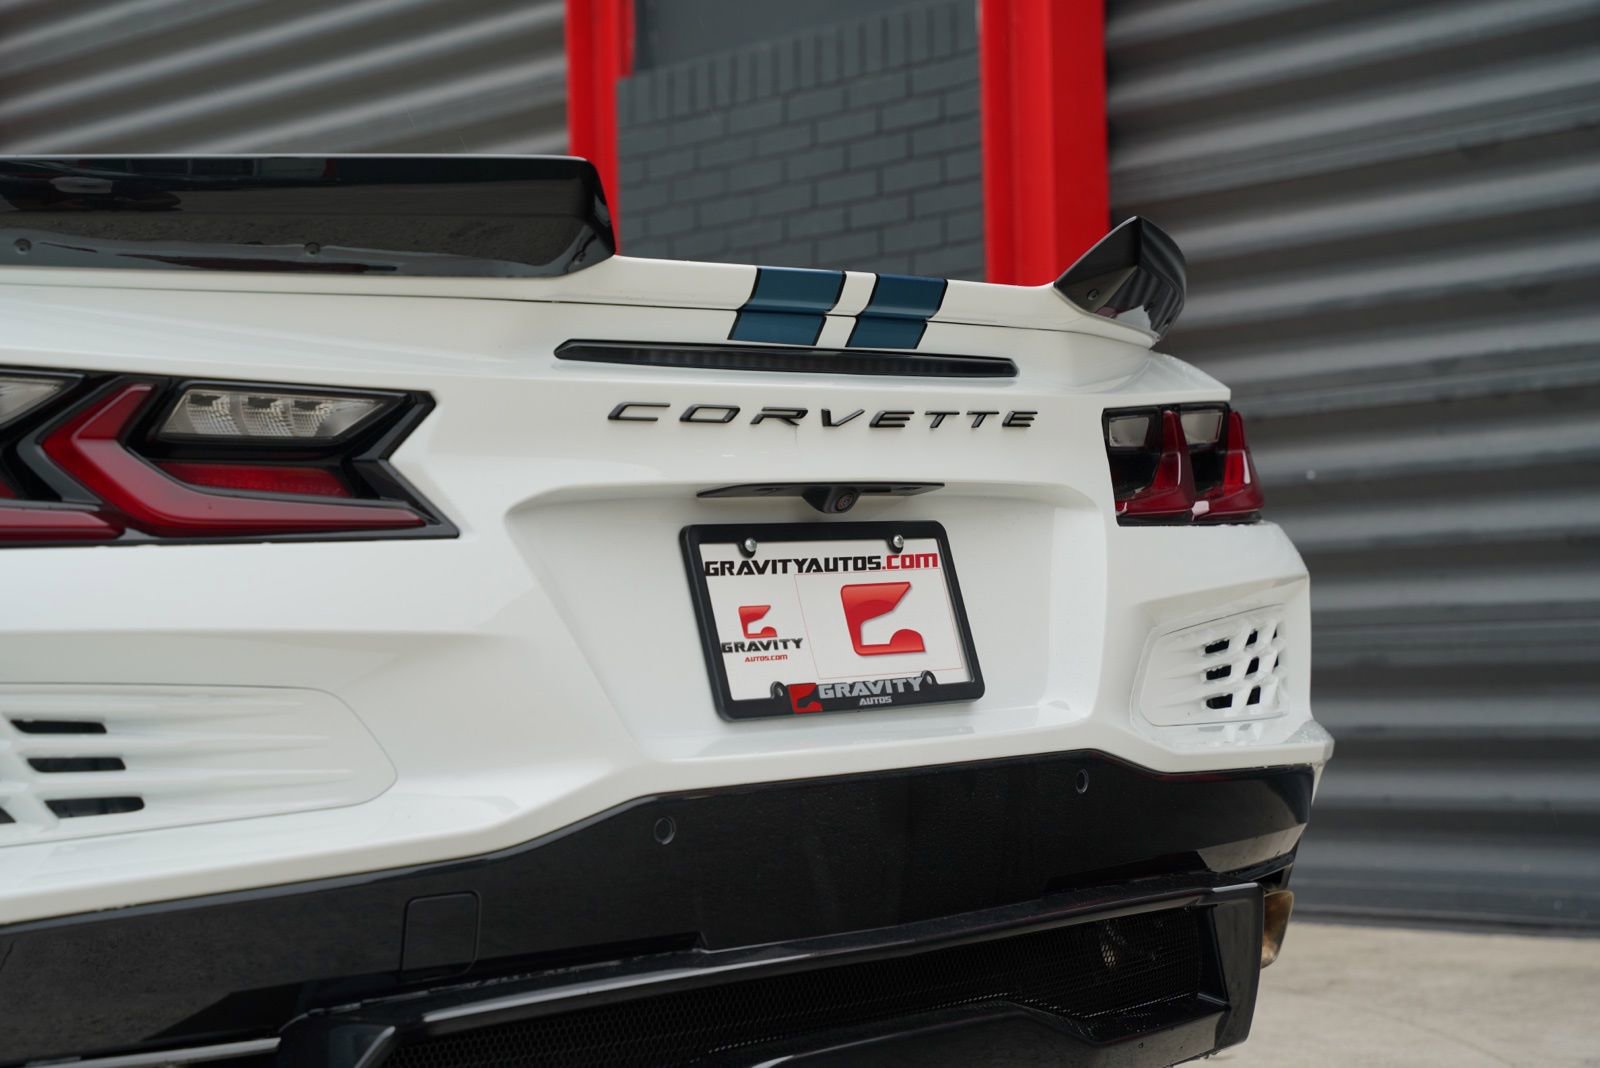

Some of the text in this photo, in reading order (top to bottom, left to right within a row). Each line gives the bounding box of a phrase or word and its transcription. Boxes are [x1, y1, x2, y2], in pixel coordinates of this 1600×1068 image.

[607, 402, 1039, 428] CORVETTE
[721, 637, 804, 654] GRAVITY
[818, 676, 924, 700] GRAVITY
[859, 696, 893, 706] AUTOS
